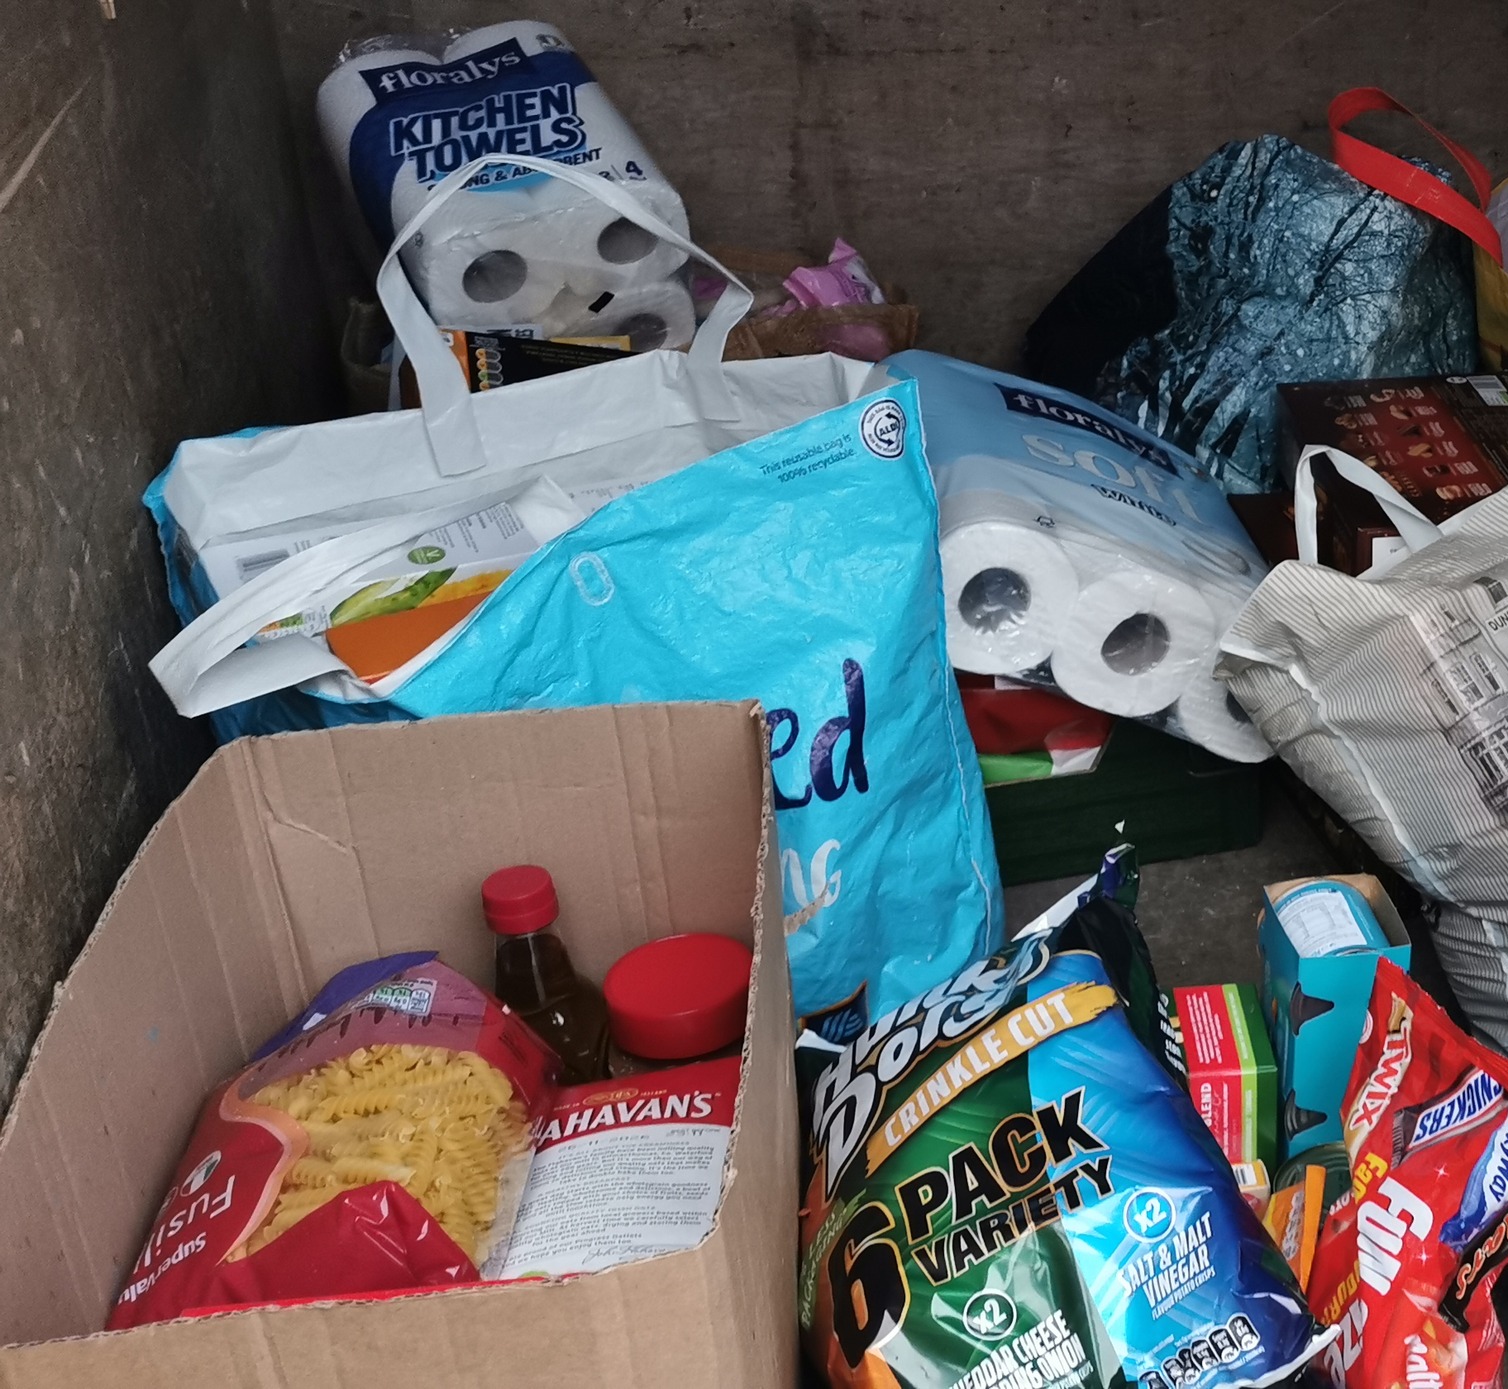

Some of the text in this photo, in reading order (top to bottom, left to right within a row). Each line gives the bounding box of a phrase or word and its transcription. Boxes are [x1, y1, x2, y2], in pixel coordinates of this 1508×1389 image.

[378, 50, 521, 93] floralys
[391, 84, 576, 155] KITCHEN
[408, 116, 586, 183] TOWELS
[884, 1029, 1009, 1148] CRINKLE
[1008, 992, 1075, 1046] CUT
[1353, 1027, 1410, 1130] TWIX
[1413, 1071, 1503, 1143] SNICKERS
[895, 1085, 1112, 1246] PACK
[911, 1157, 1115, 1288] VARIETY
[1116, 1210, 1214, 1297] SALT & MALT
[1357, 1175, 1434, 1297] FUN
[827, 1200, 911, 1369] 6
[1142, 1243, 1210, 1309] VINEGAR
[1011, 1308, 1071, 1364] CHEESE
[1036, 1332, 1087, 1382] ONION
